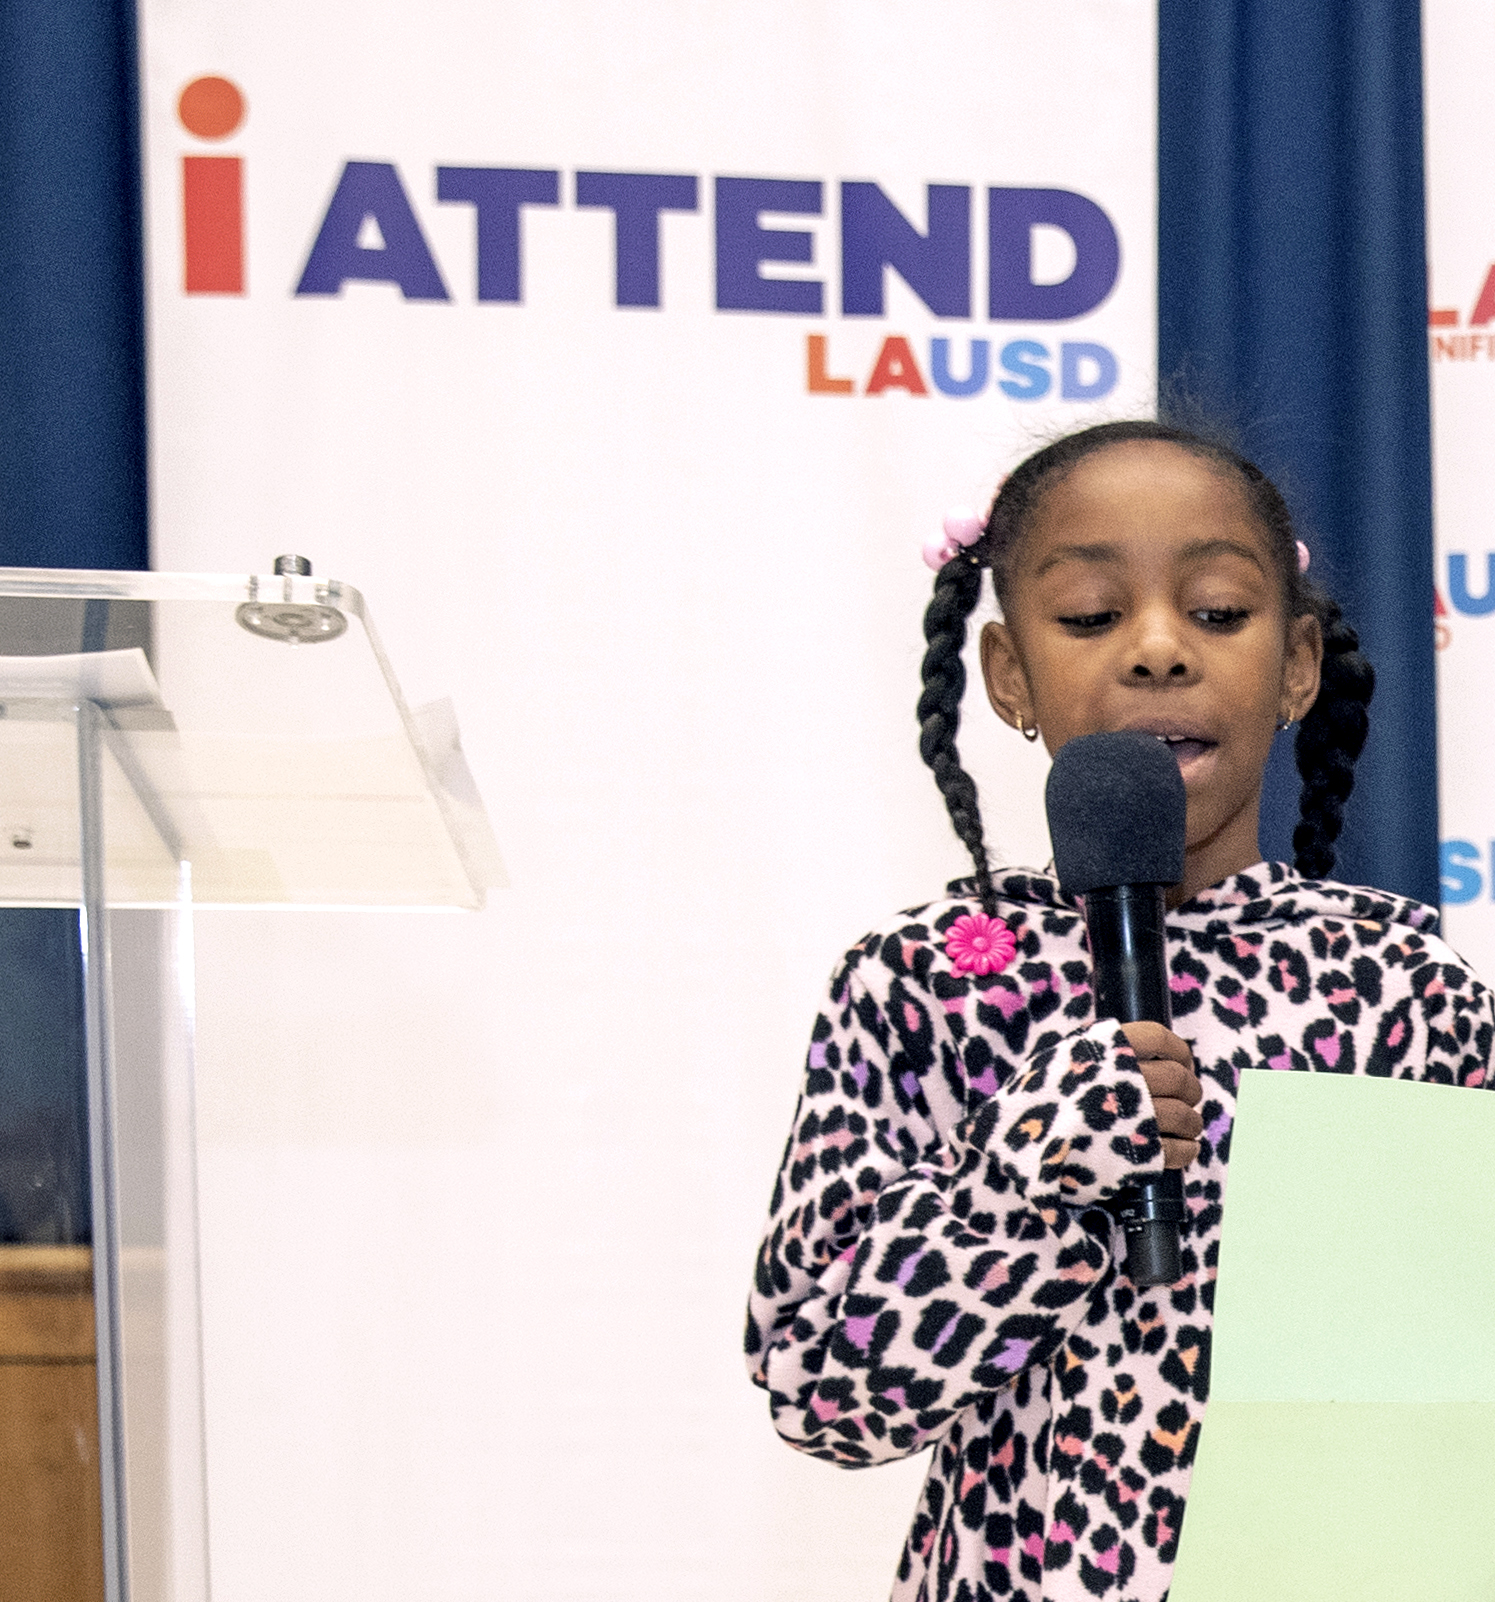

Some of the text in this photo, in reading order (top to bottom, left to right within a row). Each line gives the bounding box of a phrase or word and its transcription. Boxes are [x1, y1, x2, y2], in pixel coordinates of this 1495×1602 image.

[177, 75, 1123, 323] i ATTEND
[805, 334, 1119, 400] LAUSD
